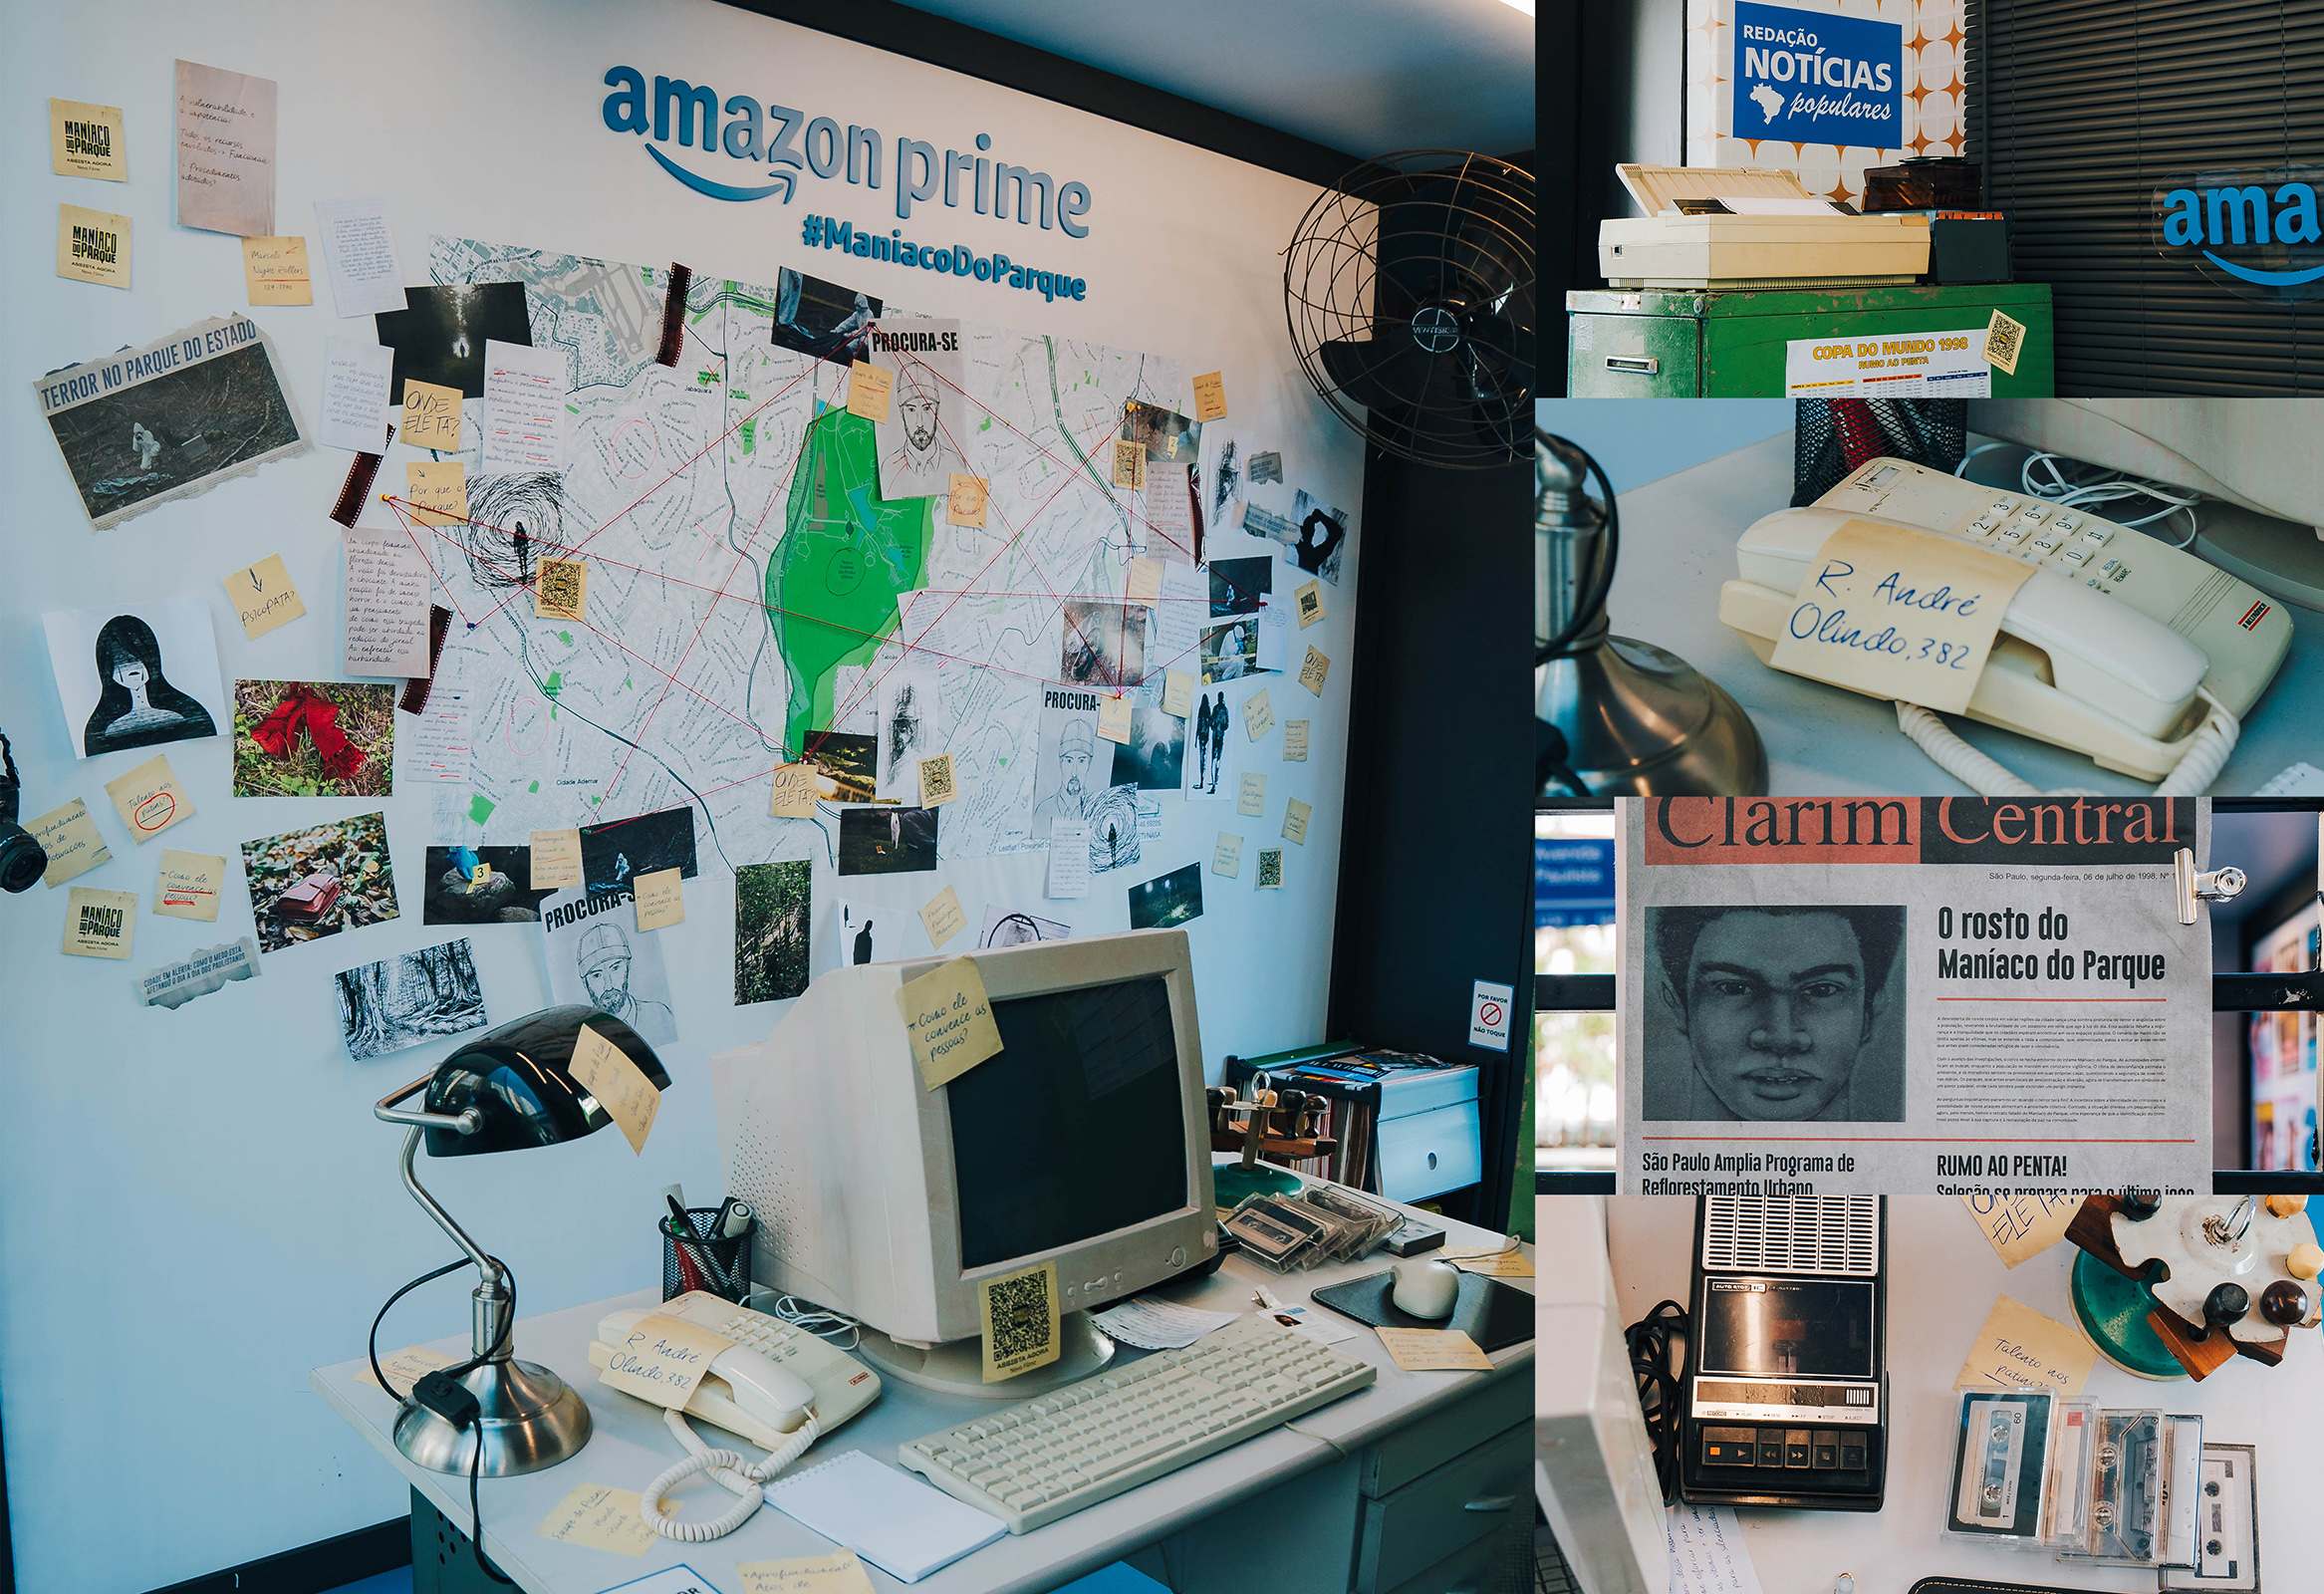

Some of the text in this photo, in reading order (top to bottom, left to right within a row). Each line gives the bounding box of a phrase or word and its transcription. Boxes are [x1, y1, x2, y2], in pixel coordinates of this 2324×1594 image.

[1743, 24, 1818, 48] REDAÇÃO
[1745, 47, 1893, 92] NOTÍCIAS
[1788, 92, 1892, 122] populares
[65, 121, 110, 146] MANÍACO
[215, 137, 244, 149] recursos
[74, 137, 111, 158] PARQUE
[602, 64, 1092, 238] amazon prime
[73, 225, 117, 254] MANÍACO
[71, 261, 96, 269] ASSISTA
[81, 243, 117, 264] PARQUE
[251, 250, 281, 260] Marcelo
[801, 213, 1087, 302] #ManiacoDoParque
[253, 266, 304, 278] Night Rollers
[872, 332, 959, 352] PROCURA-SE
[1812, 337, 1968, 360] COPA DO MUNDO 1998
[41, 319, 257, 410] TERROR NO PARQUE DO ESTADO
[1858, 356, 1930, 370] RUMO AO PENTA
[405, 390, 449, 413] ONDE
[685, 386, 712, 394] Jabaquara
[404, 414, 431, 434] ELE
[435, 485, 452, 499] que
[2056, 521, 2072, 530] 9
[1873, 571, 1978, 617] André
[775, 771, 807, 788] ONDE
[128, 782, 172, 809] Talento nos
[775, 790, 794, 806] ELE
[1657, 797, 2180, 849] Clarim Central
[57, 834, 67, 843] de
[166, 883, 204, 893] convence
[168, 870, 208, 883] Como ele
[2031, 873, 2080, 882] segunda-feira,
[2105, 873, 2123, 881] julho
[2137, 872, 2157, 881] 1998,
[81, 905, 123, 928] MANÍACO
[1937, 906, 2068, 940] O rosto do
[87, 920, 121, 938] PARQUE
[144, 974, 161, 987] CIDADE
[163, 971, 170, 980] EM
[193, 957, 208, 969] COMO
[214, 950, 228, 961] MEDO
[147, 979, 171, 995] AFETANDO
[177, 974, 186, 983] DIA
[192, 969, 201, 978] DIA
[201, 965, 211, 975] DOS
[213, 952, 246, 970] PAULISTANOS
[1937, 947, 2167, 989] Maníaco do Parque
[918, 992, 968, 1028] Como ele
[924, 1004, 987, 1043] convence as
[929, 1028, 969, 1063] pessoas?
[1643, 1153, 1855, 1177] São Paulo Amplia Programa de
[1937, 1155, 2067, 1177] RUMO AO PENTA!
[1643, 1178, 1759, 1195] Reflorestamento
[654, 1339, 702, 1364] André
[996, 1347, 1049, 1370] ASSISTA AGORA
[1995, 1337, 2070, 1386] Talento nos
[1010, 1363, 1023, 1373] Novo
